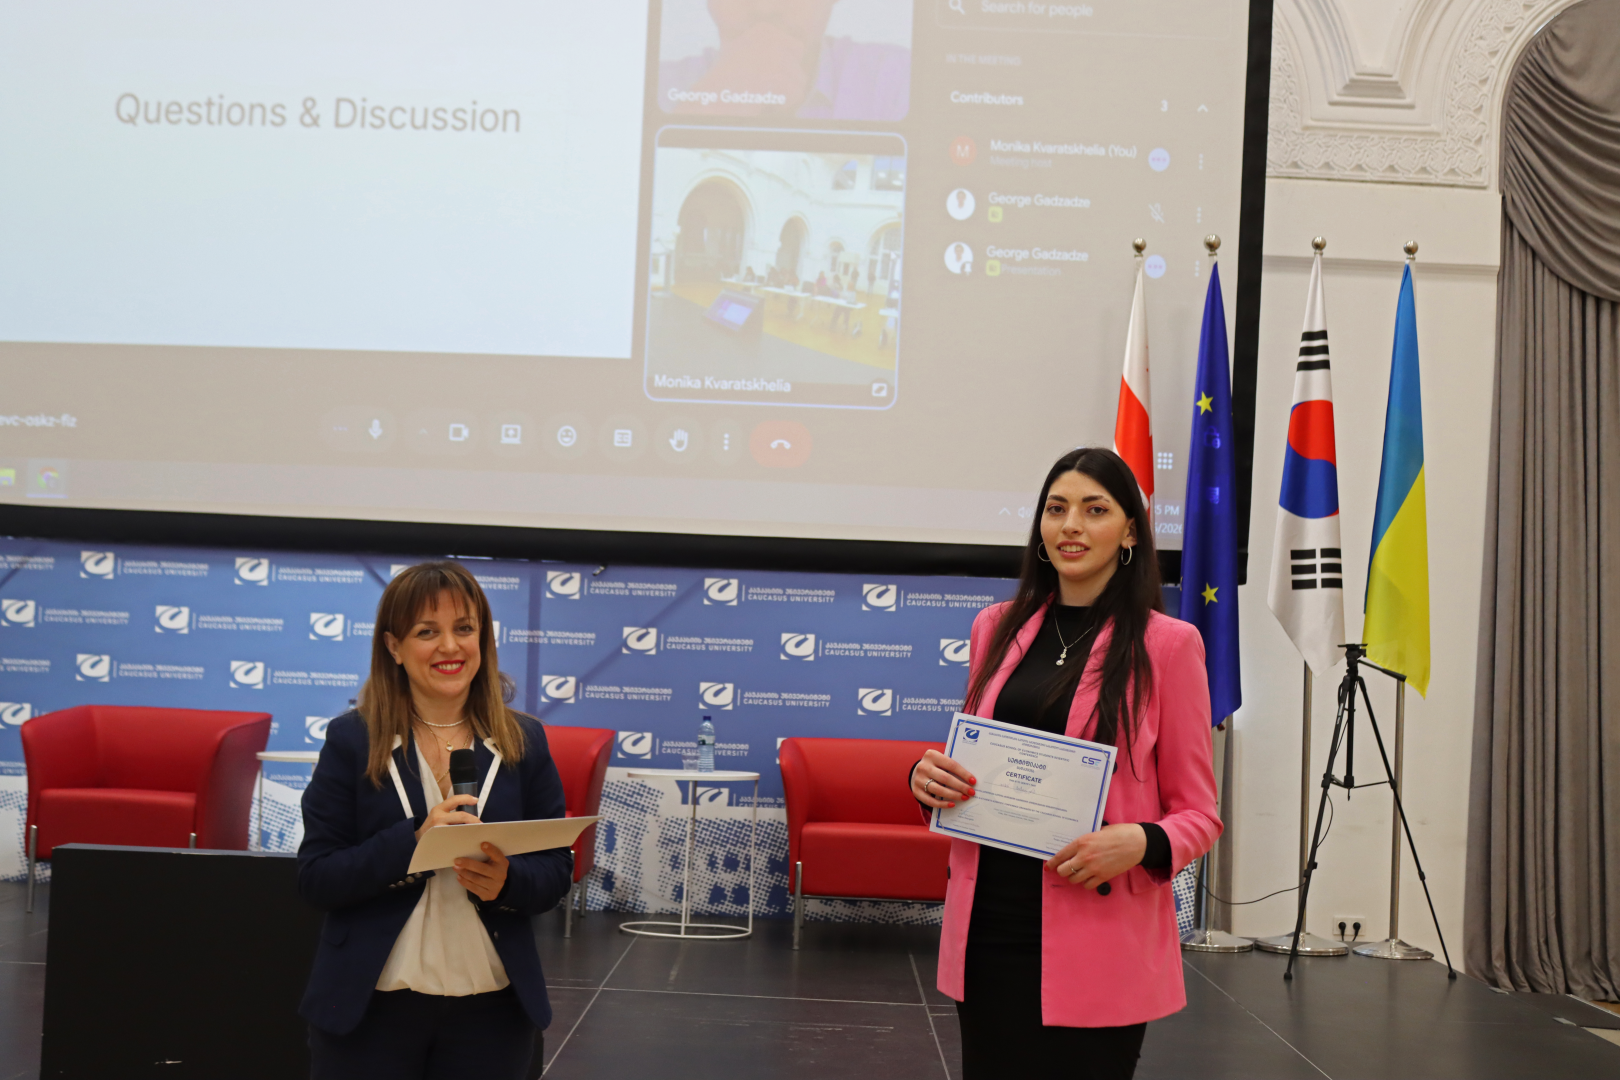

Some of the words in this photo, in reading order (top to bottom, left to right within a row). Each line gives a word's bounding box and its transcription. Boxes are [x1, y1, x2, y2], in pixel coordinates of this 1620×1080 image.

[1028, 1, 1045, 14] for
[1049, 3, 1093, 18] people
[668, 88, 717, 105] George
[720, 90, 786, 105] Gadzadze
[950, 90, 1024, 105] Contributors
[115, 92, 287, 127] Questions
[299, 97, 320, 128] &
[334, 97, 521, 132] Discussion
[1160, 99, 1168, 112] 3
[956, 145, 970, 158] M
[990, 139, 1031, 153] Monika
[1033, 141, 1106, 156] Kvaratskhelia
[1108, 144, 1137, 159] (You)
[988, 192, 1031, 208] George
[1034, 194, 1091, 208] Gadzadze
[986, 245, 1029, 261] George
[1031, 247, 1089, 261] Gadzadze
[654, 374, 701, 389] Monika
[704, 376, 791, 392] Kvaratskhelia
[1164, 505, 1180, 516] PM
[278, 574, 317, 582] CAUCASUS
[509, 636, 548, 644] CAUCASUS
[1005, 771, 1042, 783] CERTIFICATE
